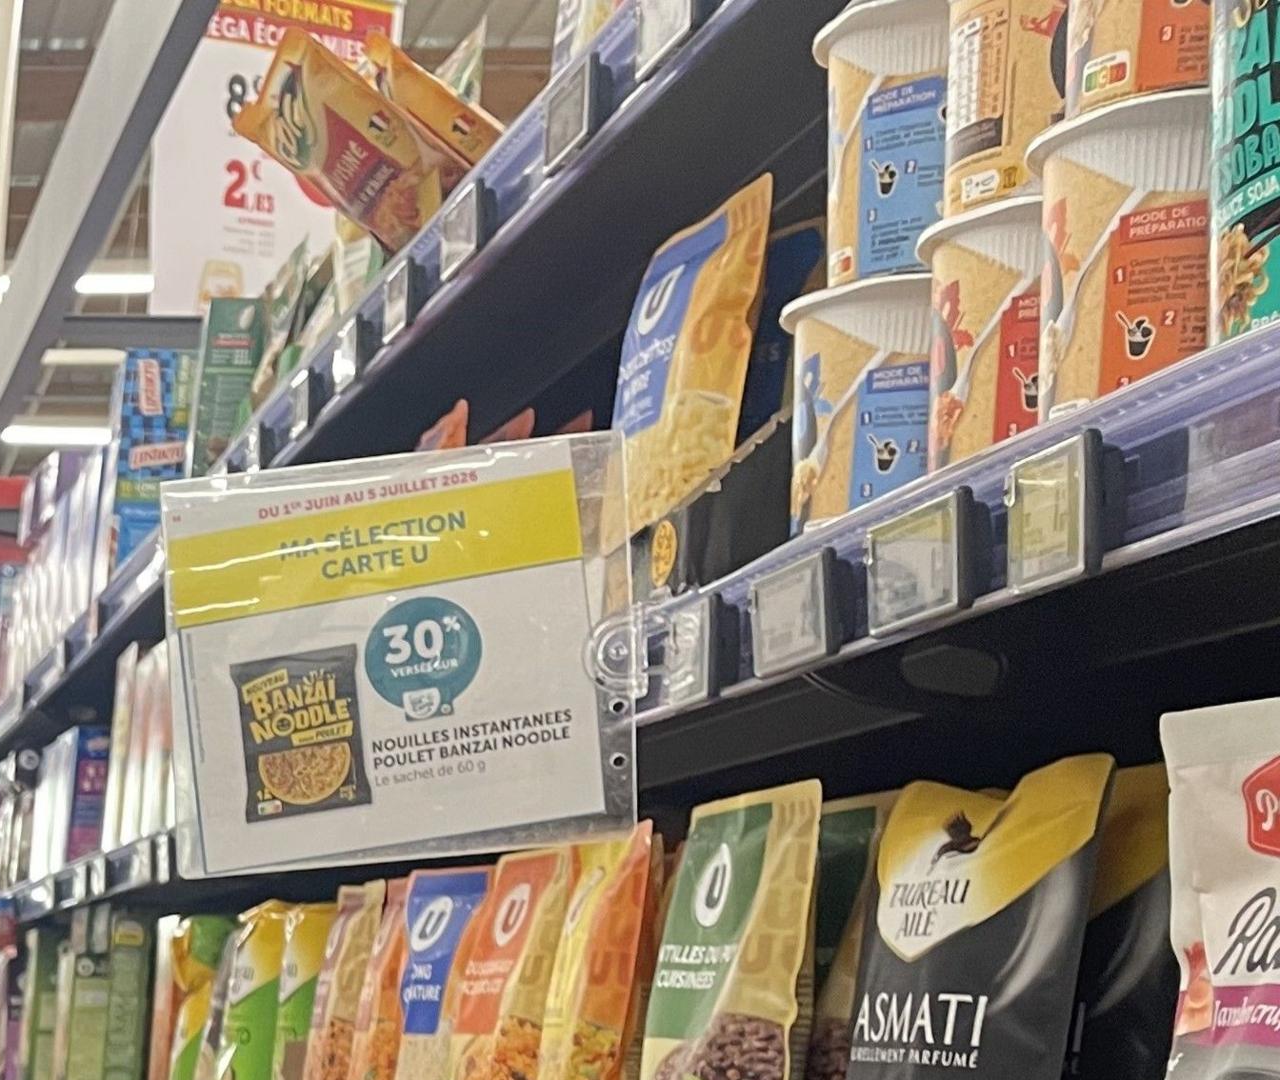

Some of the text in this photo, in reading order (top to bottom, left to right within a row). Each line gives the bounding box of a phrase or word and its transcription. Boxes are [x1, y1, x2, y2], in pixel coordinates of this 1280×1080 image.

[208, 15, 251, 43] ÉGA
[224, 160, 247, 208] 2
[1129, 207, 1189, 226] MODE DE
[1129, 214, 1208, 239] PRÉPARATIO
[258, 505, 279, 520] DU
[306, 497, 340, 512] JUIN
[344, 490, 364, 504] AU
[368, 488, 377, 501] 5
[380, 477, 440, 498] JUILLET
[279, 511, 466, 561] MA SÉLECTION
[321, 544, 429, 580] CARTE U
[249, 699, 351, 744] NOODLE
[372, 730, 450, 753] NOUILLES
[374, 726, 571, 769] POULET BANZAI NOODLE
[375, 760, 486, 788] Le sachet de 60 g
[889, 876, 971, 913] TAUREAU
[896, 906, 938, 941] AILÉ
[853, 991, 989, 1047] ASMATI
[908, 1049, 978, 1069] PARFUMÉ
